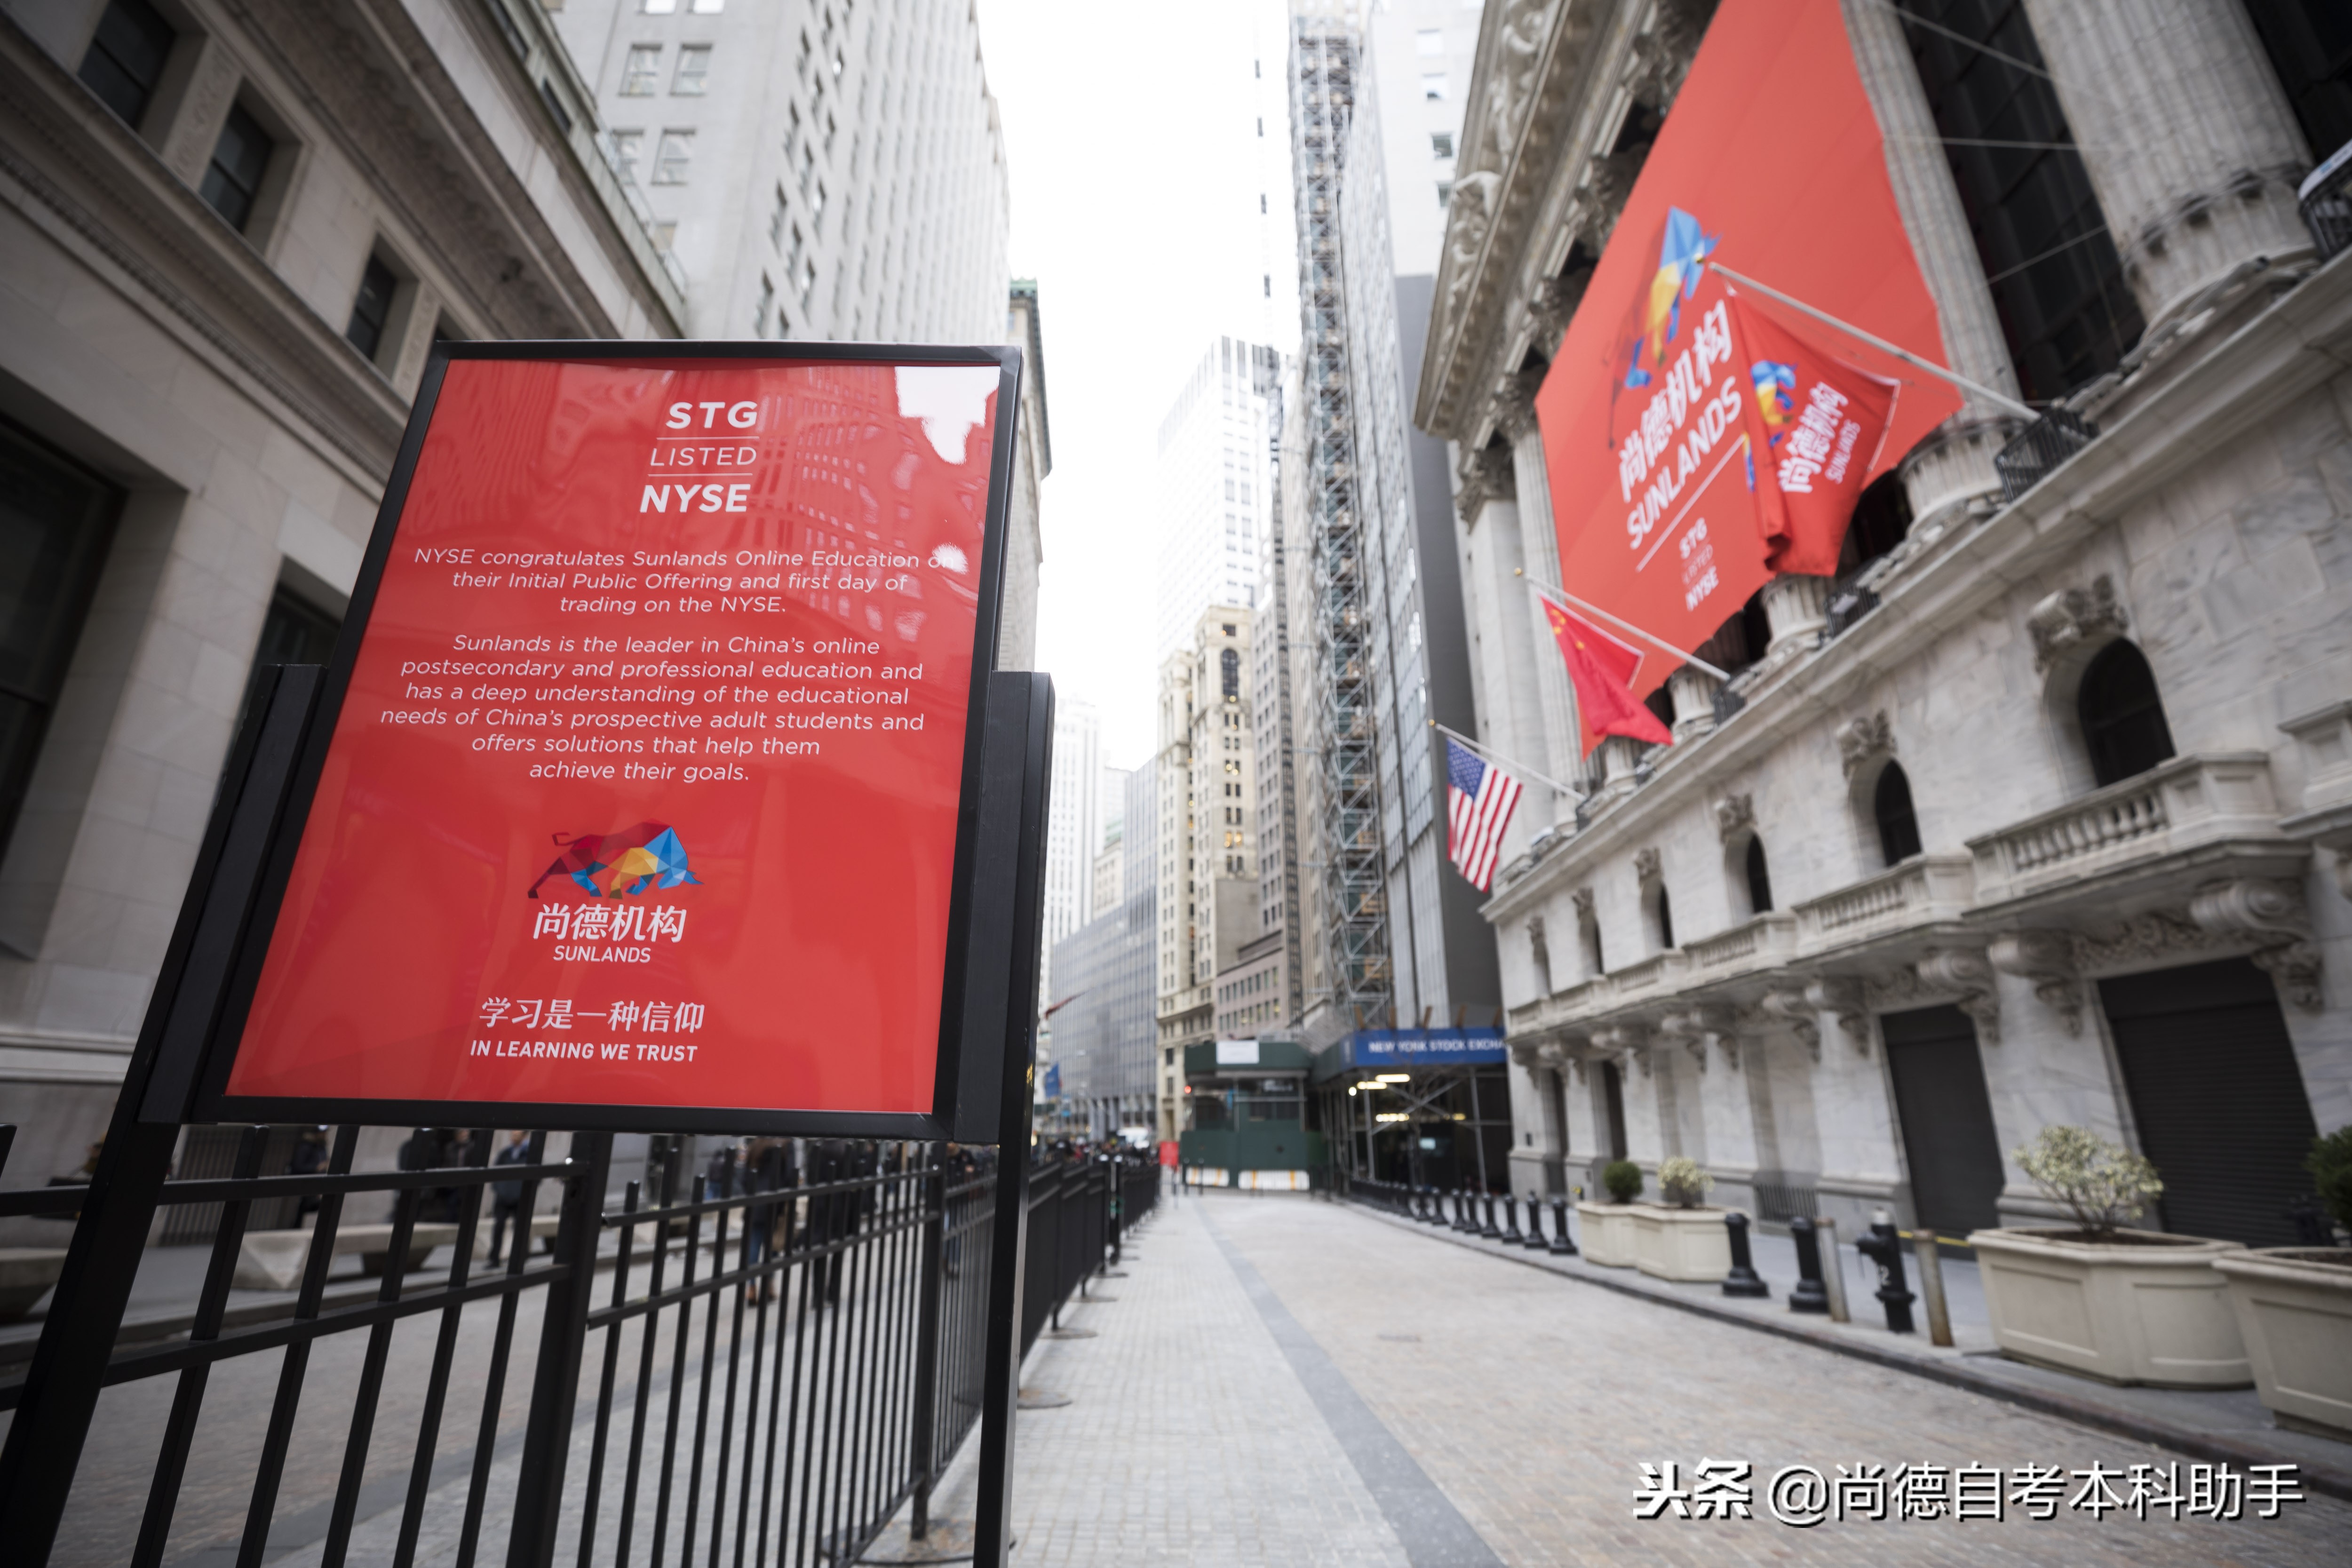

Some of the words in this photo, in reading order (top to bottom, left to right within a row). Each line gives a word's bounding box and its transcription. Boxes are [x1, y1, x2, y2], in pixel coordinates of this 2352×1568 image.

[1618, 300, 1732, 503] 尚德机构
[666, 401, 757, 429] STG
[650, 447, 756, 466] LISTED
[1627, 376, 1741, 550] SUNLANDS
[640, 484, 751, 513] NYSE
[1679, 517, 1708, 560] STG
[415, 549, 475, 564] NYSE
[482, 551, 624, 567] congratulates
[633, 551, 727, 566] Sunlands
[736, 550, 803, 565] Online
[812, 551, 919, 567] Education
[453, 572, 501, 587] their
[509, 573, 565, 588] Initial
[573, 573, 636, 589] Public
[645, 573, 732, 591] Offering
[740, 573, 780, 589] and
[789, 573, 830, 589] first
[838, 573, 878, 593] day
[885, 574, 908, 591] of
[1685, 565, 1719, 612] NYSE
[561, 597, 636, 615] trading
[644, 600, 670, 612] on
[679, 597, 712, 612] the
[721, 597, 785, 612] NYSE.
[453, 635, 551, 651] Sunlands
[559, 636, 574, 652] is
[584, 636, 617, 652] the
[626, 637, 693, 653] leader
[701, 637, 719, 653] in
[728, 637, 804, 653] China's
[813, 637, 879, 654] online
[401, 660, 564, 679] postsecondary
[572, 661, 613, 677] and
[620, 661, 754, 680] professional
[762, 661, 872, 678] education
[881, 663, 922, 679] and
[406, 682, 443, 699] has
[451, 687, 463, 699] a
[472, 684, 526, 703] deep
[535, 685, 695, 705] understanding
[704, 685, 727, 702] of
[734, 686, 768, 702] the
[777, 686, 908, 704] educational
[381, 708, 447, 724] needs
[455, 708, 480, 724] of
[486, 709, 563, 726] China's
[571, 711, 702, 730] prospective
[710, 711, 767, 728] adult
[775, 712, 873, 729] students
[882, 713, 924, 730] and
[472, 734, 536, 751] offers
[544, 735, 644, 753] solutions
[653, 736, 697, 753] that
[706, 737, 753, 757] help
[763, 737, 819, 755] them
[530, 761, 614, 779] achieve
[625, 762, 676, 780] their
[683, 763, 748, 783] goals.
[533, 903, 686, 943] 尚德机构
[553, 946, 651, 963] SUNLANDS
[479, 997, 705, 1033] 学习是一种信仰
[470, 1040, 491, 1056] IN
[496, 1041, 594, 1059] LEARNING
[601, 1043, 630, 1060] WE
[636, 1044, 698, 1062] TRUST
[1368, 1040, 1396, 1053] NEW
[1397, 1039, 1428, 1052] YORK
[1429, 1038, 1467, 1052] STOCK
